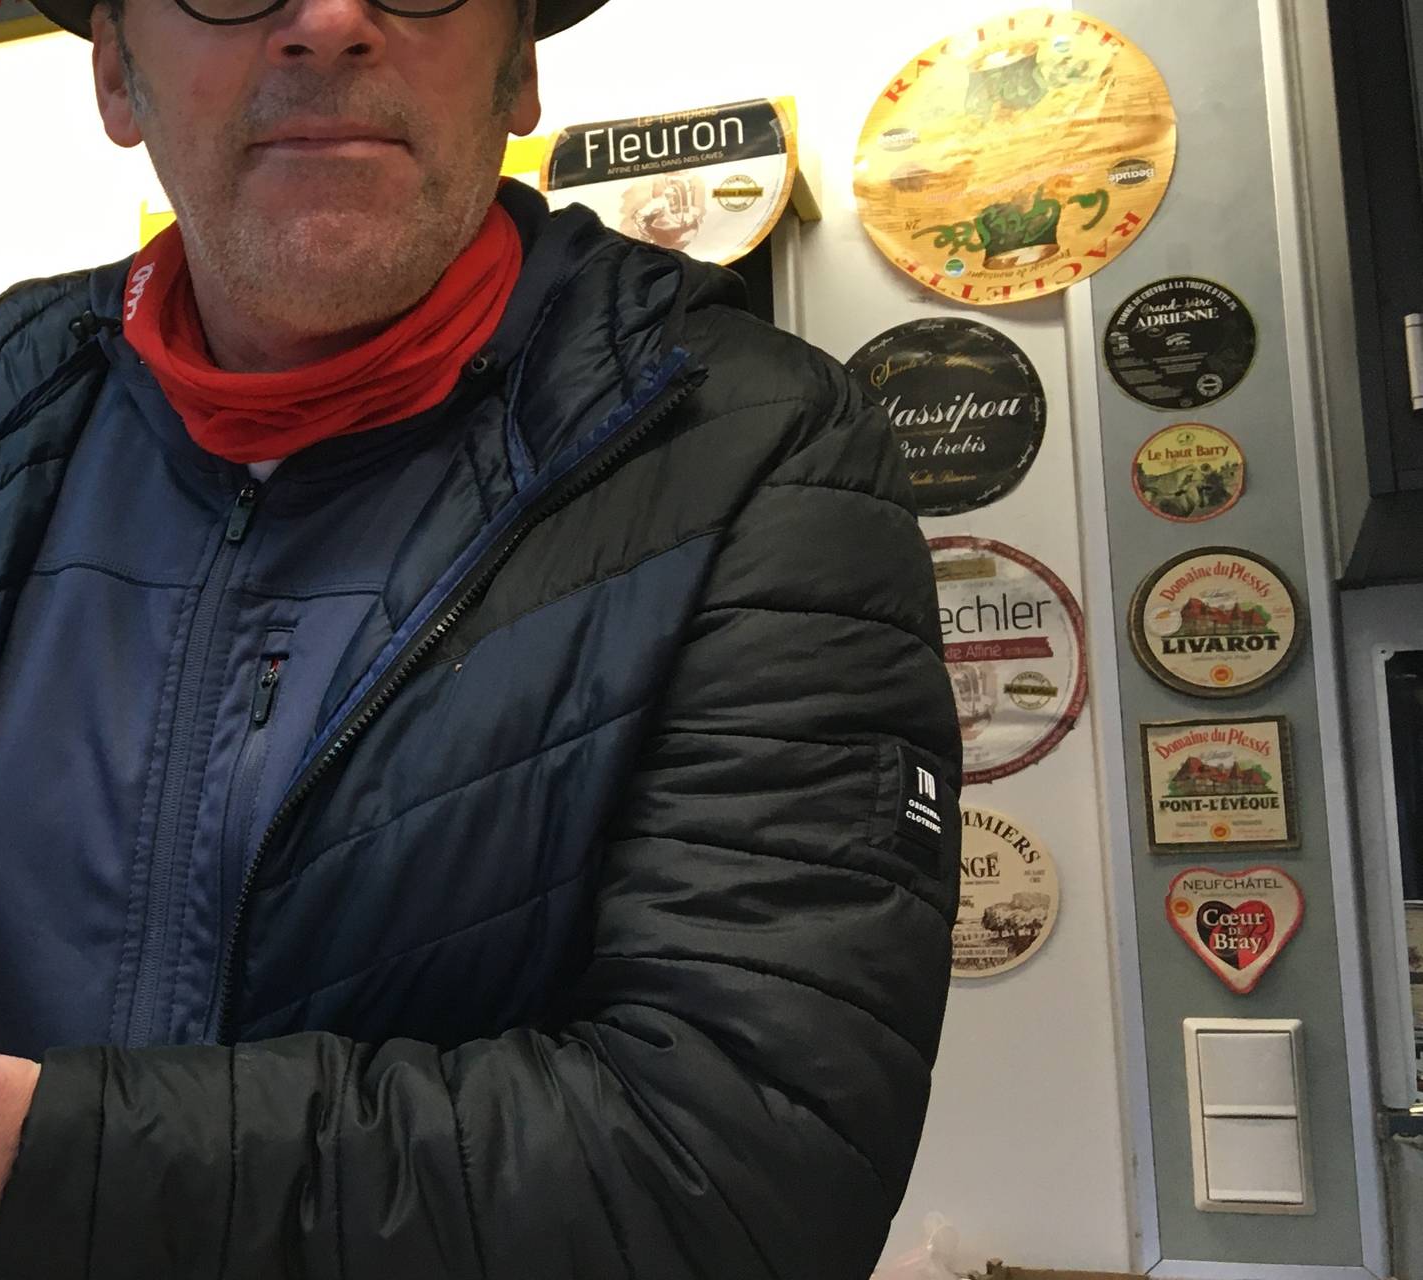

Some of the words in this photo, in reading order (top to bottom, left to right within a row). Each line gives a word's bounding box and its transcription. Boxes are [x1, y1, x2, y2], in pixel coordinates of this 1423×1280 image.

[585, 116, 744, 168] Fleuron
[1134, 307, 1219, 329] ADRIENNE
[1148, 449, 1161, 461] Le
[1165, 447, 1192, 459] haut
[1196, 445, 1229, 457] Barry
[1159, 566, 1212, 602] Domaine
[1212, 561, 1228, 577] du
[1227, 561, 1271, 598] Plessis
[1161, 635, 1280, 654] LIVAROT
[1153, 730, 1209, 759] Domaine
[1210, 728, 1226, 742] du
[1228, 727, 1272, 756] Plessis
[905, 810, 941, 834] CLOTHING
[1183, 877, 1283, 890] NEUFCHÂTEL
[1202, 909, 1265, 926] Cœur
[1213, 933, 1263, 954] Bray
